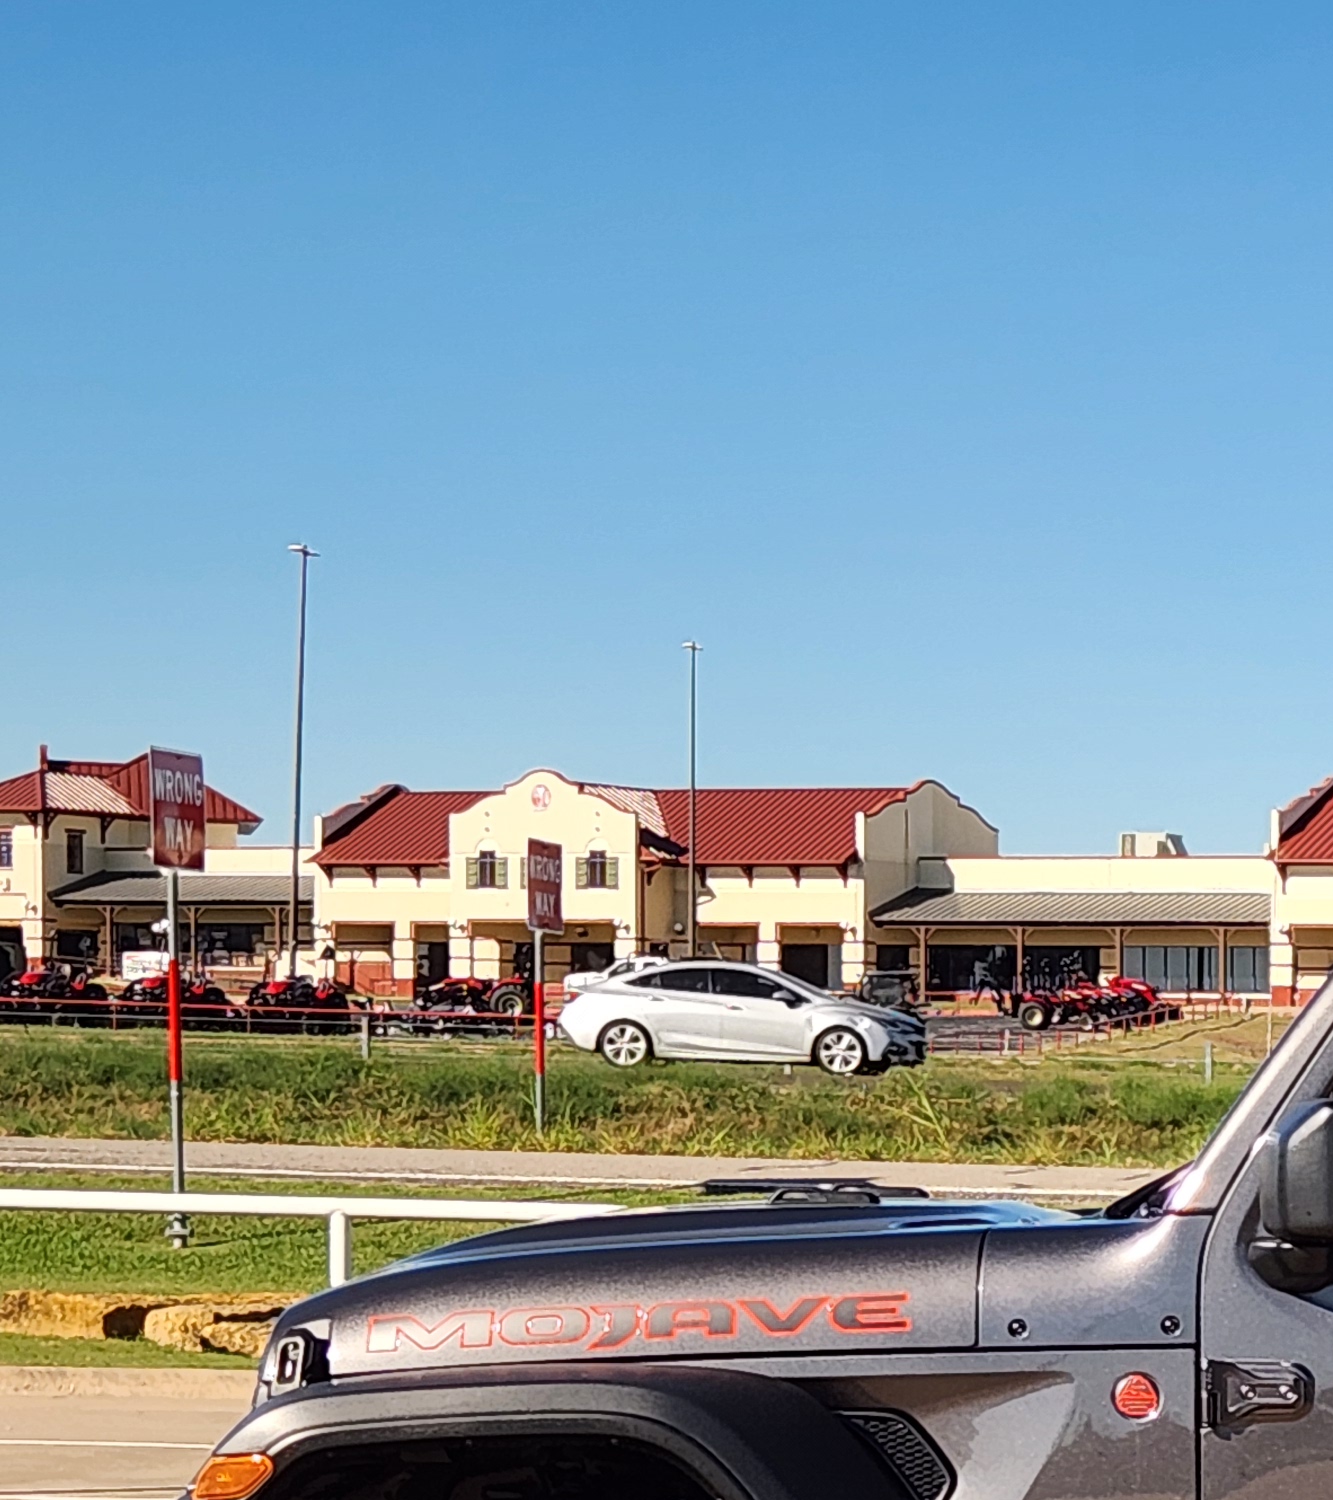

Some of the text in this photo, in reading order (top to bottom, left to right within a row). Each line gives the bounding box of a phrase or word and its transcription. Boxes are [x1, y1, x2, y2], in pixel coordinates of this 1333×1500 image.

[154, 768, 202, 806] WRONG
[164, 817, 193, 852] WAY
[535, 891, 555, 917] WAY
[366, 1292, 911, 1353] MOJAVE
